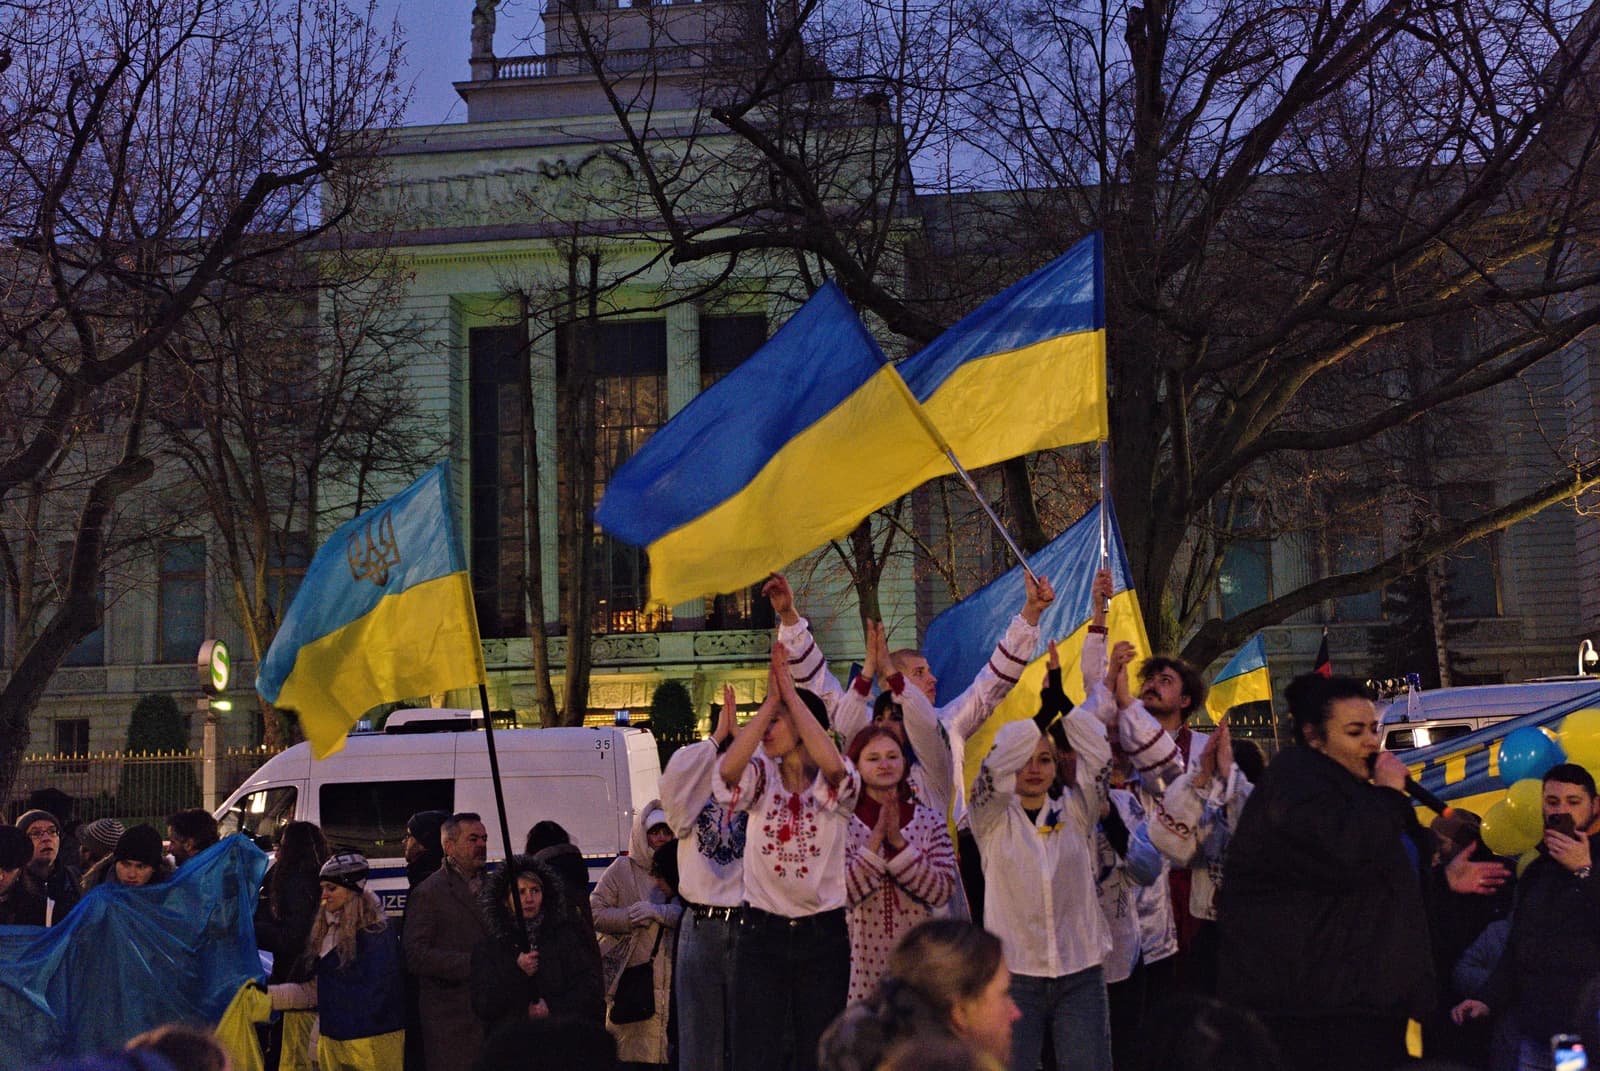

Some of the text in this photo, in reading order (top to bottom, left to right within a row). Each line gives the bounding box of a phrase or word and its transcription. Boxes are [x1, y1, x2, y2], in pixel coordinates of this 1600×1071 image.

[213, 645, 228, 690] S
[595, 739, 610, 750] 35
[382, 895, 407, 908] IZE
